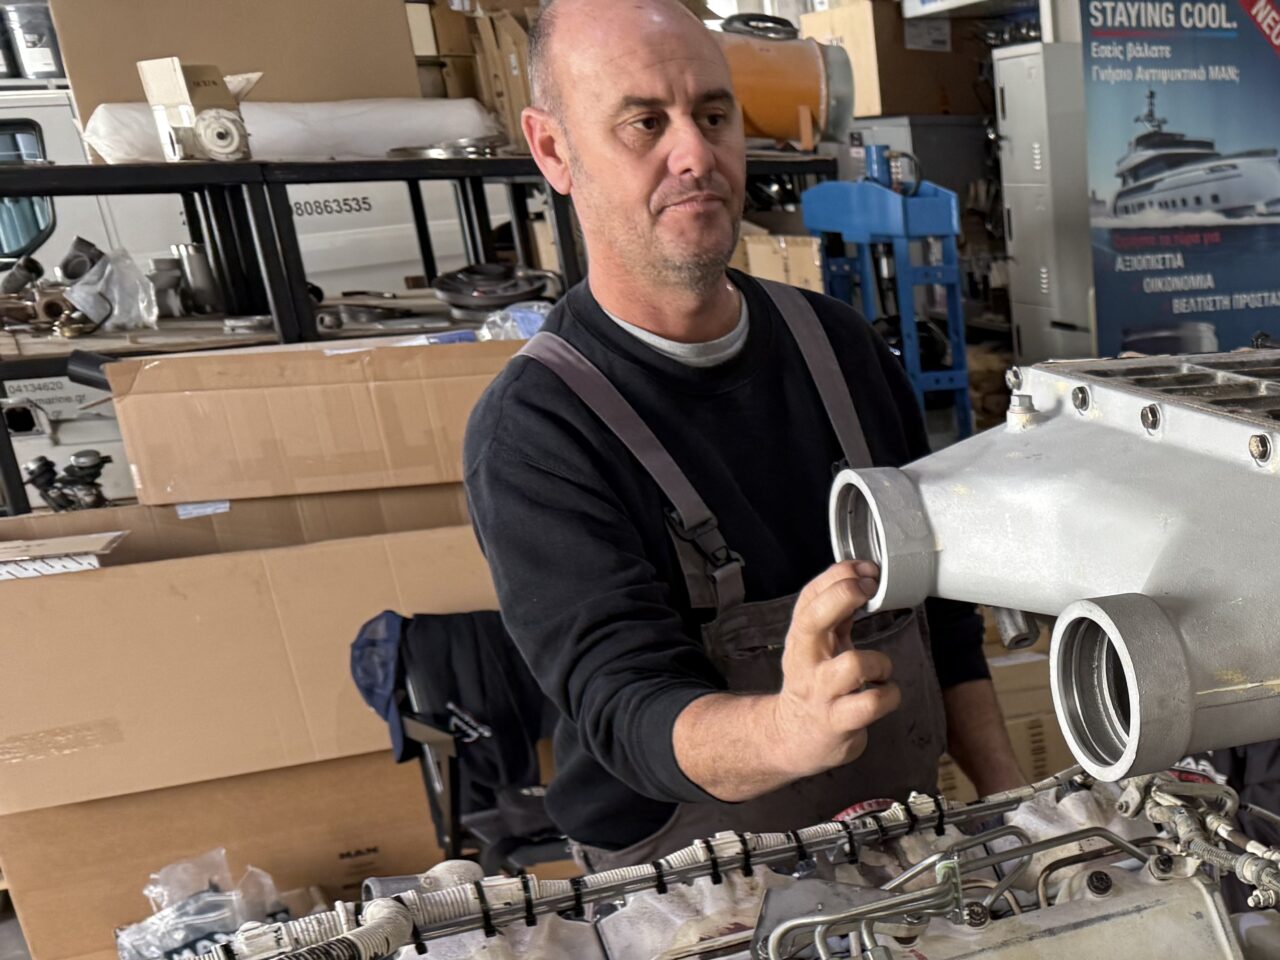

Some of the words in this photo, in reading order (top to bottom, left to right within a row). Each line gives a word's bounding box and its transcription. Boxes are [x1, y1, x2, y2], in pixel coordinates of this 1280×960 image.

[1089, 2, 1175, 28] STAYING
[1180, 2, 1238, 29] COOL.
[290, 196, 372, 217] 80863535
